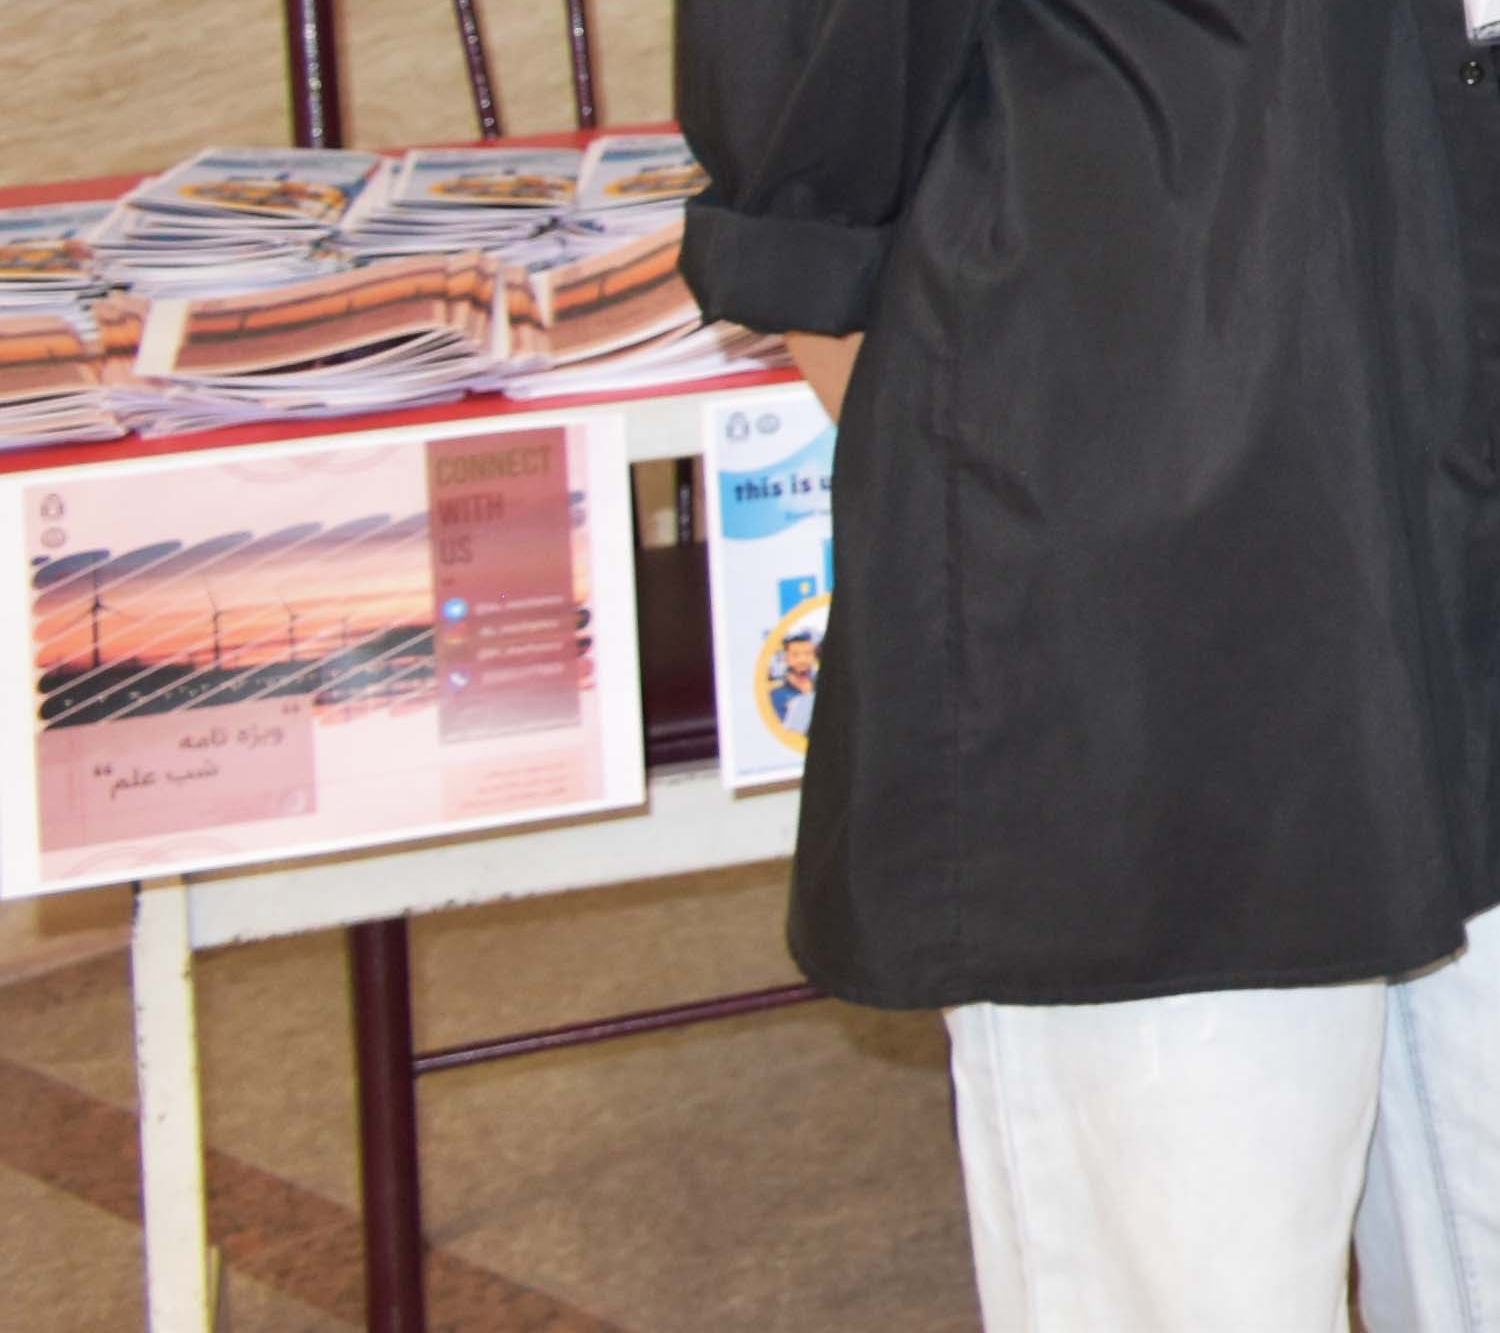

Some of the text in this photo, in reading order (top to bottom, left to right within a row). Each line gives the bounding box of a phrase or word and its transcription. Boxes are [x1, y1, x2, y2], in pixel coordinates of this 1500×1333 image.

[435, 444, 553, 488] CONNECT
[735, 476, 783, 503] this
[437, 492, 505, 526] WITH
[438, 534, 474, 566] US
